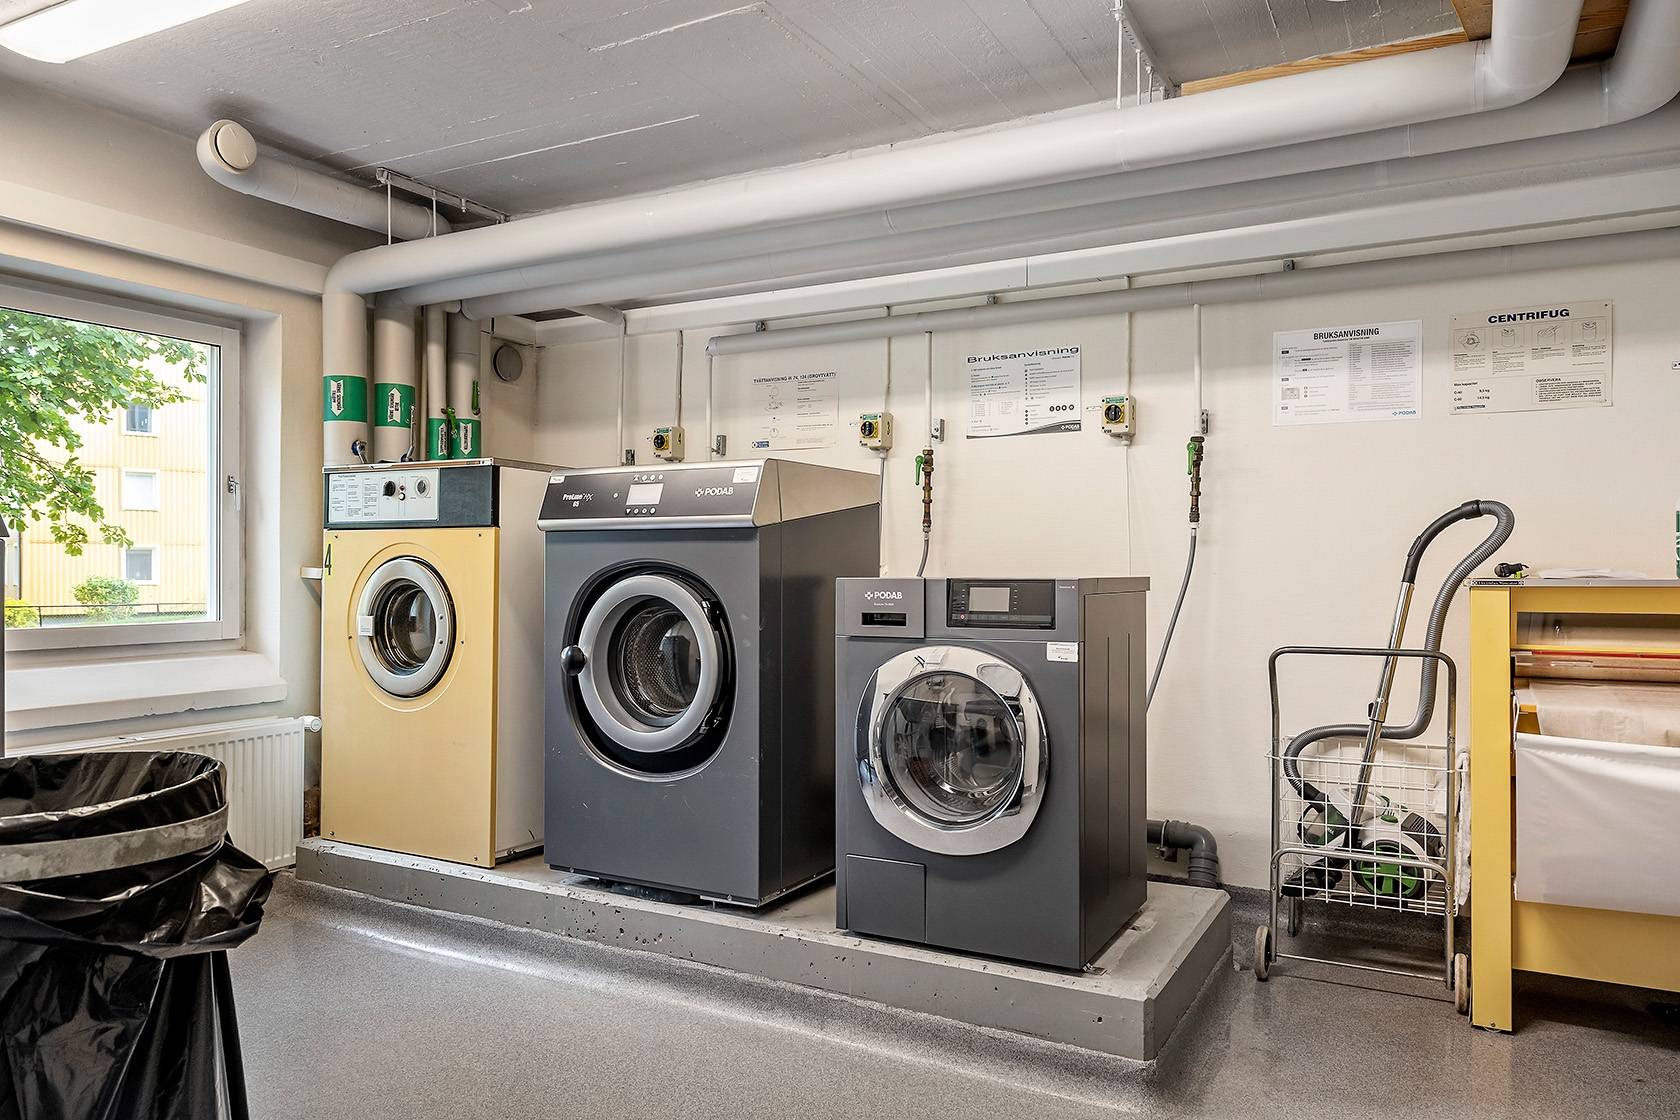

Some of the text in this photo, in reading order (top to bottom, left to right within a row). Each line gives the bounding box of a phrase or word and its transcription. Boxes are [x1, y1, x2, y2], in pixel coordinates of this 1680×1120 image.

[1488, 308, 1570, 324] CENTRIFUG
[1313, 327, 1380, 340] BRUKSANVISNING
[967, 346, 1079, 364] Bruksanvisning
[703, 486, 735, 497] PODAB
[324, 543, 332, 576] 4
[874, 591, 903, 600] PODAB
